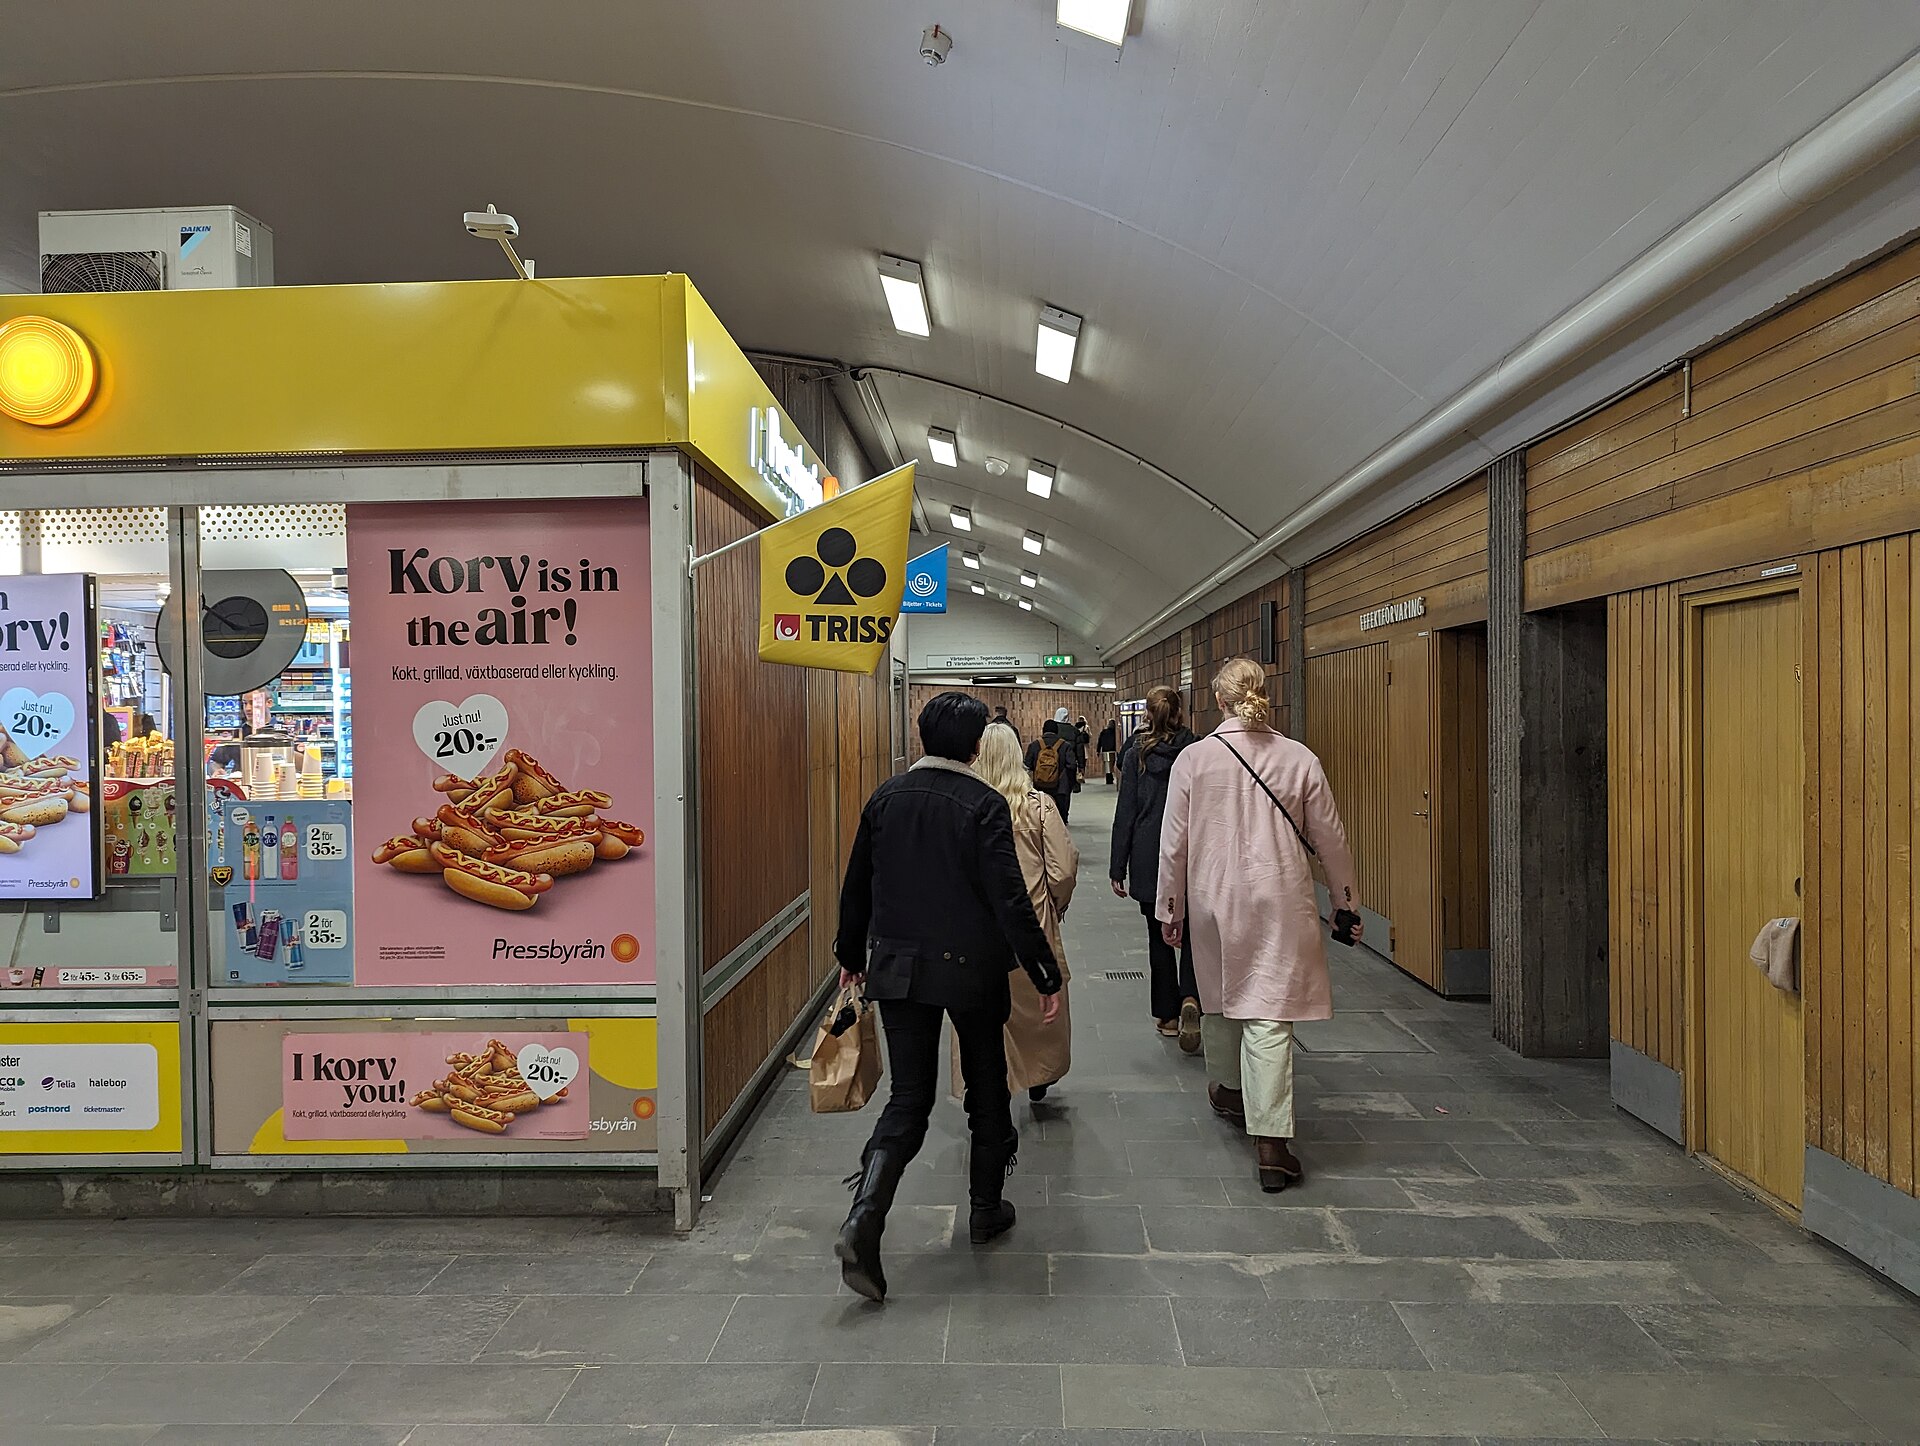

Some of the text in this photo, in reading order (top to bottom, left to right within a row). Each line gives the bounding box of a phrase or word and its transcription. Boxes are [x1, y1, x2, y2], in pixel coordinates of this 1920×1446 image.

[388, 548, 619, 594] Korv is in
[917, 577, 928, 586] SL
[406, 595, 577, 647] the air!
[1360, 596, 1426, 631] EFFEKTFÖRVARING
[0, 611, 70, 651] rv!
[805, 614, 892, 643] TRISS
[21, 661, 37, 671] eller
[38, 660, 71, 673] kyckling.
[392, 663, 619, 683] Kokt, grillad, växtbaserad eller kyckling.
[21, 700, 53, 715] Just nu!
[11, 712, 60, 737] 20:-
[442, 709, 482, 728] Just nu!
[434, 728, 497, 757] 20:-
[311, 827, 333, 840] 2 för
[311, 842, 342, 855] 35:-
[28, 879, 68, 889] Pressbyrån
[310, 915, 333, 928] 2 för
[310, 930, 341, 943] 35:-
[492, 938, 605, 964] Pressbyrån
[62, 972, 69, 981] 2
[79, 972, 99, 981] 45:-
[104, 972, 111, 981] 3
[121, 972, 143, 981] 65:-
[0, 1055, 20, 1067] ster
[292, 1052, 397, 1081] I korv
[535, 1054, 561, 1066] Just nu!
[527, 1063, 568, 1083] 20:-
[56, 1080, 76, 1088] Telia
[89, 1079, 127, 1089] halebop
[342, 1080, 406, 1108] you!
[28, 1105, 70, 1114] postnord
[292, 1109, 407, 1119] Kokt, grillad, växtbaserad eller kyckling.
